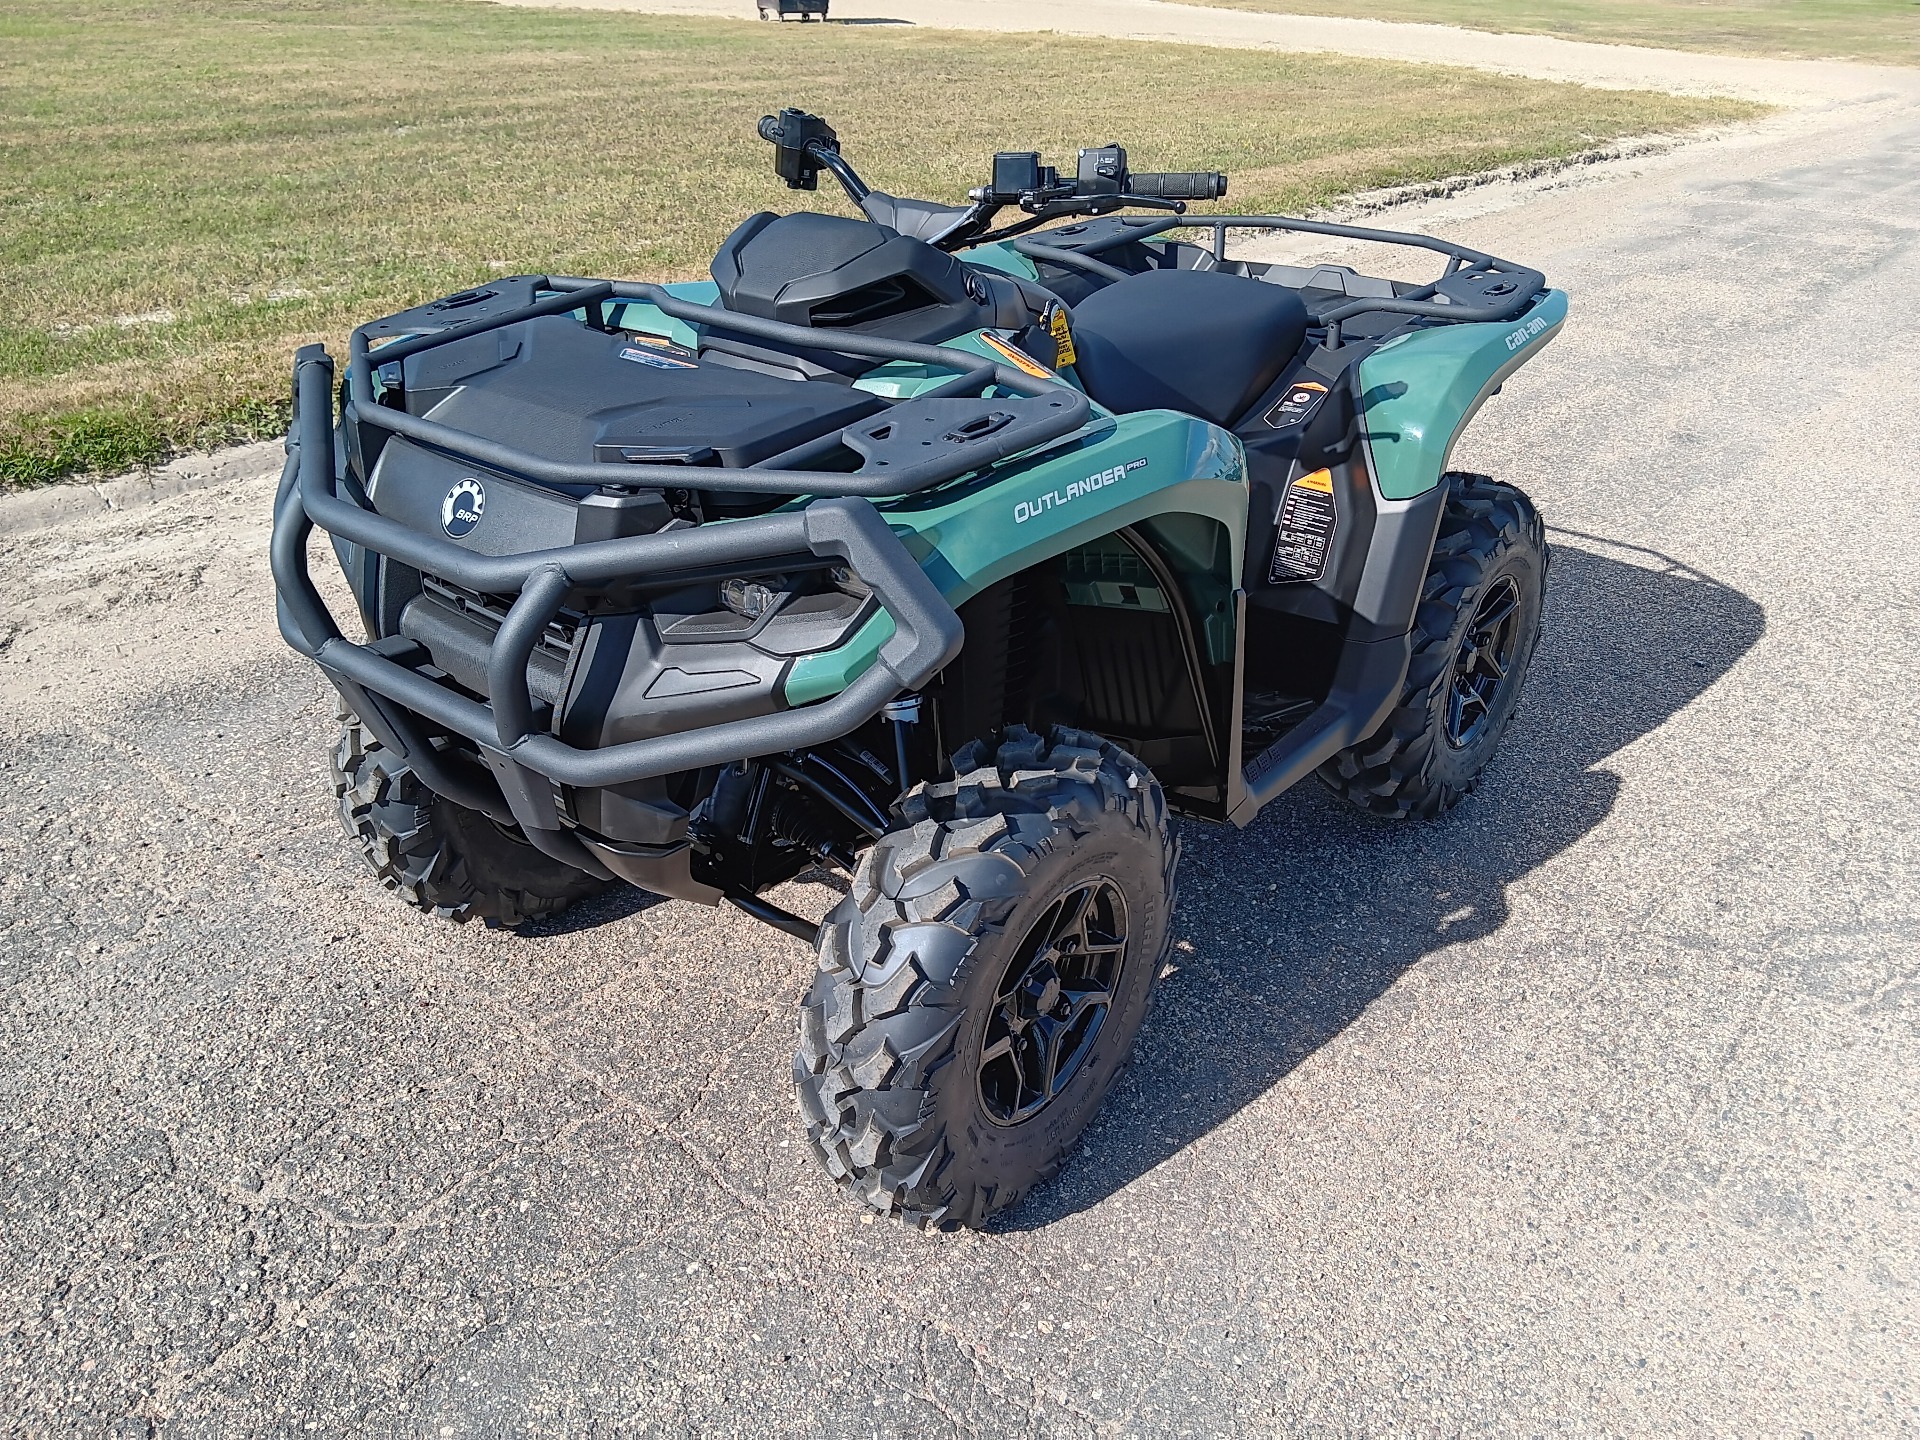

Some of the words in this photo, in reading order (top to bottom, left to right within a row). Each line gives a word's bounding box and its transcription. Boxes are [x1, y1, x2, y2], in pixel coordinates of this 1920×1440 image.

[1504, 316, 1548, 351] can-am
[1014, 464, 1126, 524] OUTLANDER
[1126, 458, 1147, 471] PRO
[455, 508, 479, 523] BRP
